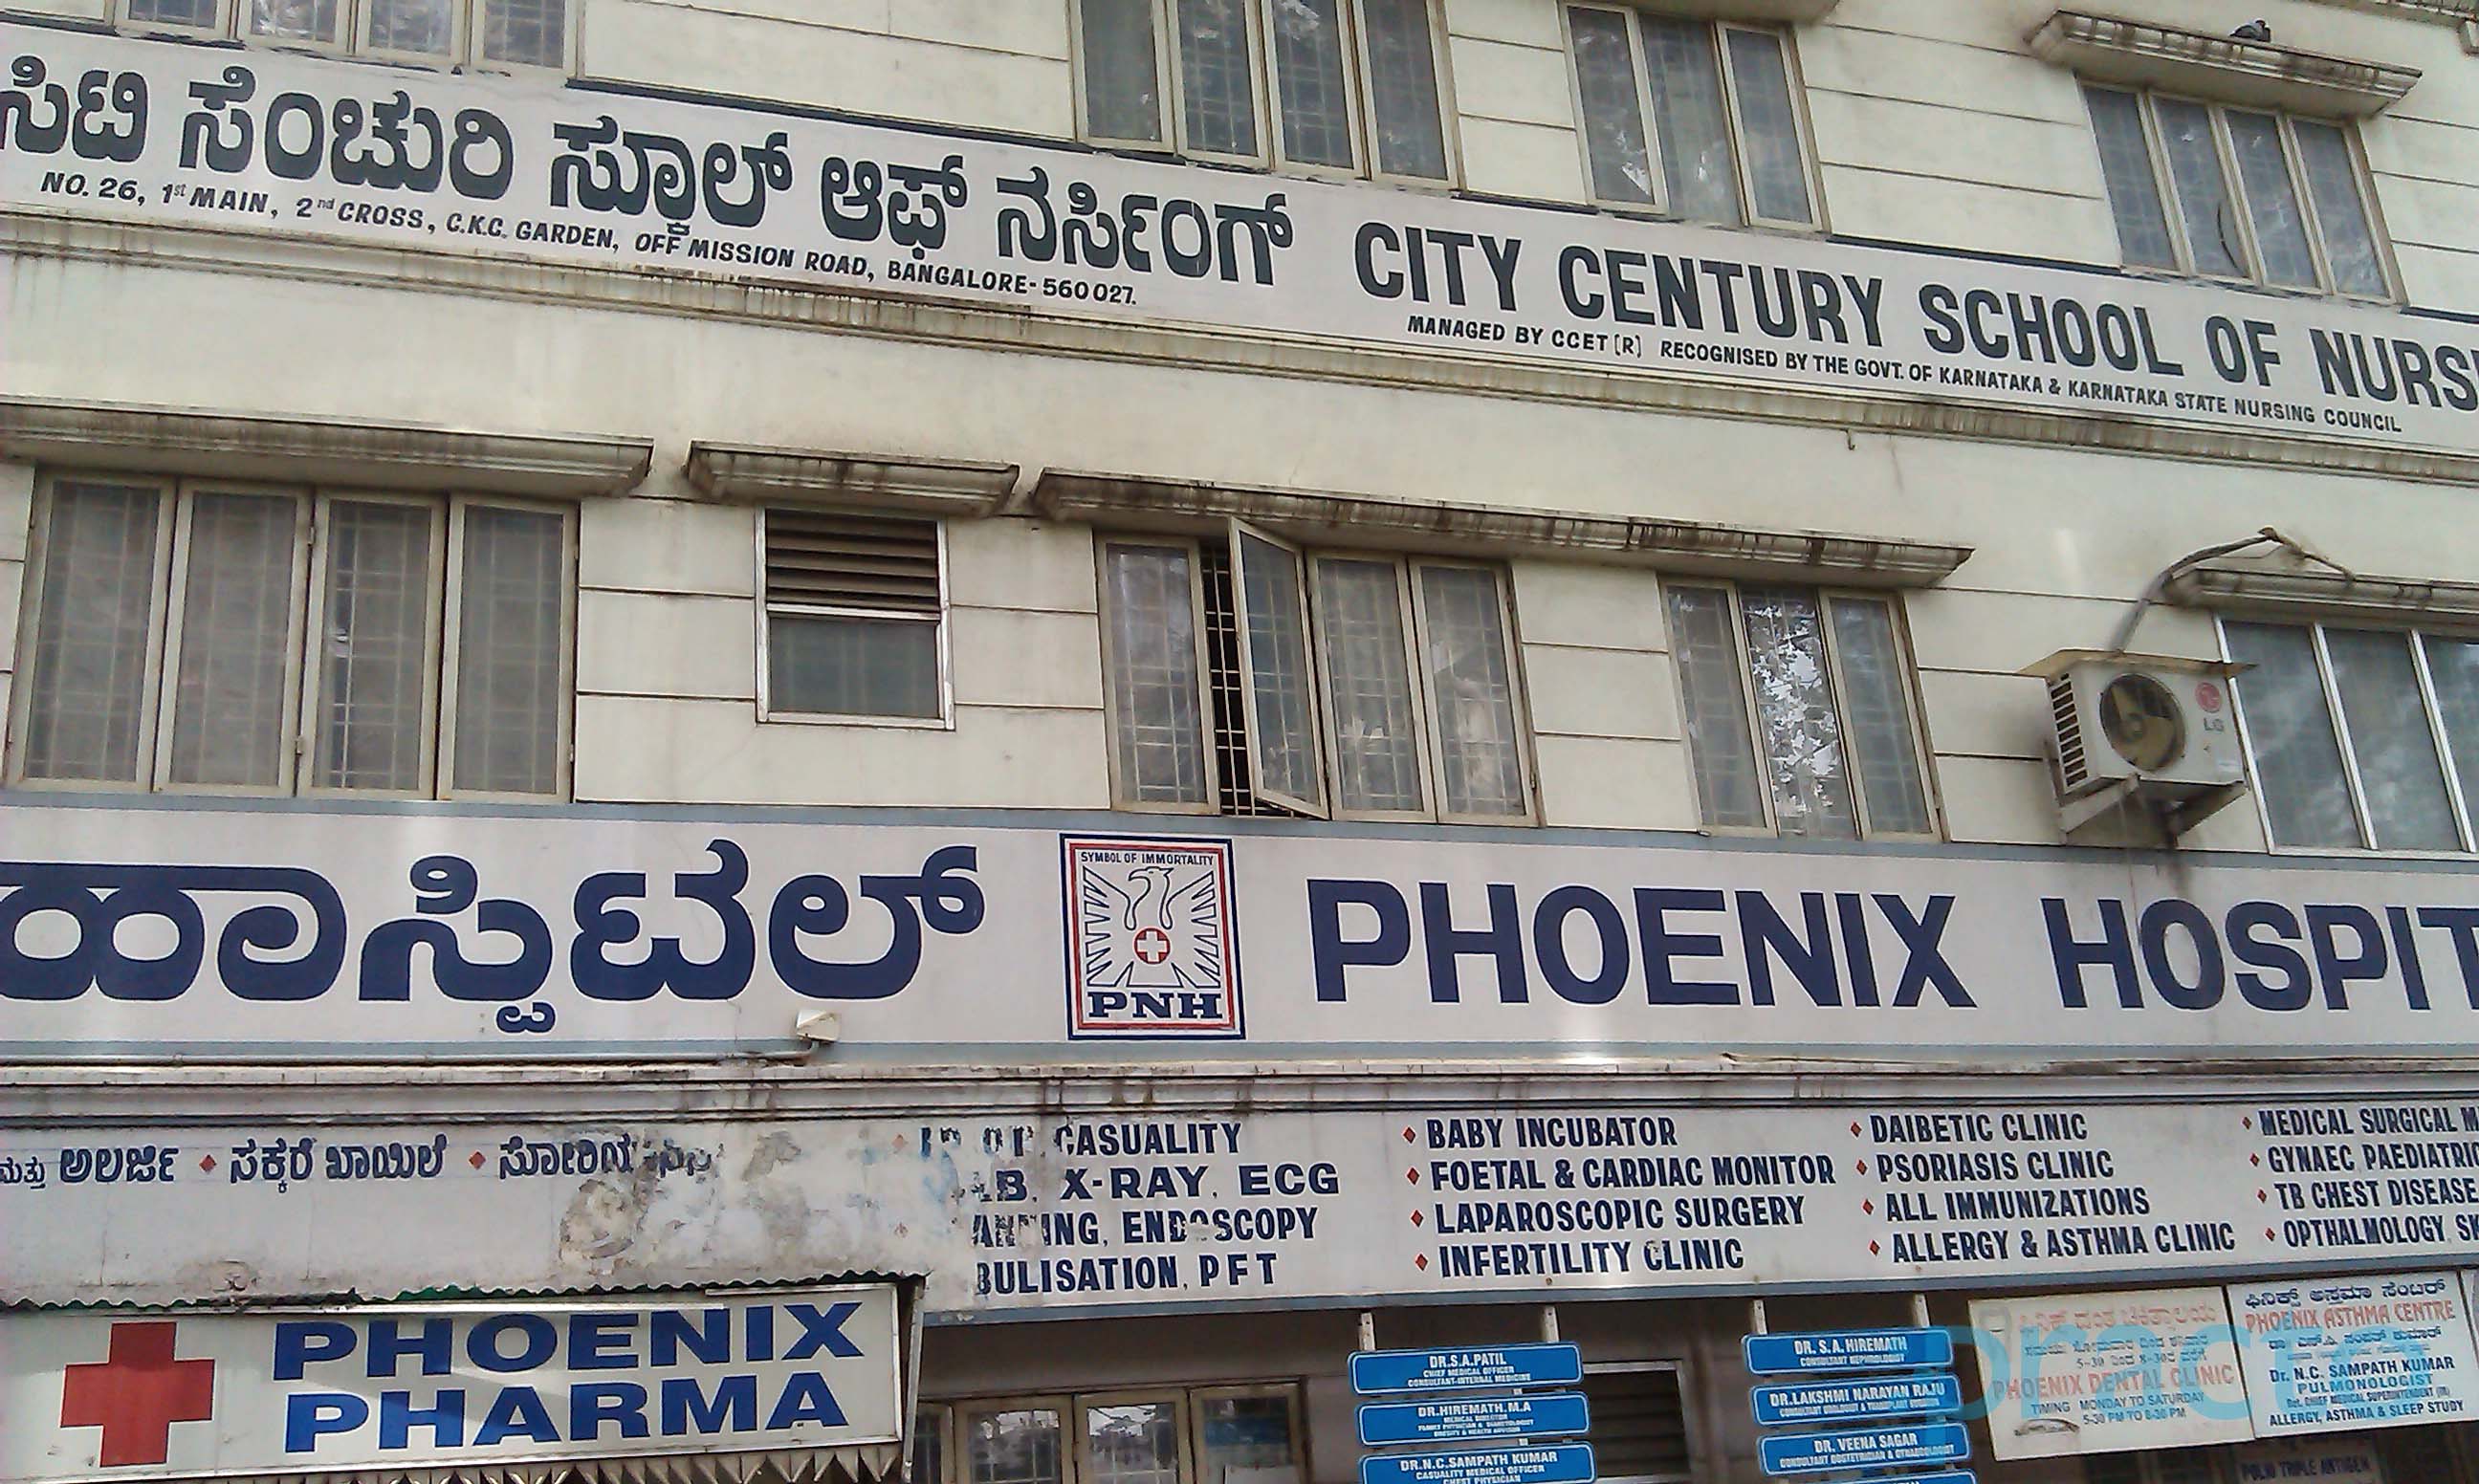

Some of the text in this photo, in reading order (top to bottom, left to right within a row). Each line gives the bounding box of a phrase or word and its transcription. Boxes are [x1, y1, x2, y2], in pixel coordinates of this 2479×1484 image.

[179, 65, 514, 199] ಸೆಂಚುರಿ
[550, 115, 792, 235] ಸ್ಕೂಲ್
[996, 165, 1295, 286] ನರ್ಸಿಂಗ್
[41, 171, 90, 197] NO.
[99, 179, 144, 207] 26,
[188, 187, 277, 218] MAIN,
[337, 202, 435, 234] CROSS,
[516, 221, 619, 252] GARDEN,
[635, 232, 681, 255] OFF
[688, 240, 794, 268] MISSION
[805, 251, 875, 283] ROAD,
[1354, 222, 1523, 312] CITY
[1558, 245, 1883, 347] CENTURY
[1918, 282, 2185, 378] SCHOOL
[2204, 315, 2282, 387] OF
[1408, 315, 1505, 341] MANAGED
[1515, 325, 1545, 345] BY
[1551, 330, 1609, 352] CCET
[1660, 339, 1779, 368] RECOGNISED
[1785, 350, 1809, 371] BY
[1812, 354, 1849, 375] THE
[1854, 359, 1904, 380] GOVT.
[1909, 364, 1933, 382] OF
[1940, 366, 2044, 395] KARNATAKA
[2049, 377, 2062, 395] &
[2068, 380, 2169, 407] KARNATAKA
[2175, 391, 2227, 414] STATE
[2234, 399, 2315, 424] NURSING
[2324, 408, 2402, 432] COUNCIL
[2204, 718, 2225, 731] LG
[1081, 851, 1214, 866] SYMBOL OF IMMORTALITY
[1305, 877, 1979, 1010] PHOENIX
[1087, 992, 1223, 1019] PNH
[1426, 1116, 1678, 1149] BABY INCUBATOR
[1869, 1112, 2088, 1144] DAIBETIC CLINIC
[2258, 1106, 2458, 1136] MEDICAL SURGICAL
[1055, 1122, 1241, 1155] CASUALITY
[1239, 1164, 1339, 1195] ECG
[1430, 1154, 1836, 1192] FOETAL & CARDIAC MONITOR
[1875, 1149, 2115, 1183] PSORIASIS CLINIC
[1886, 1187, 2151, 1222] ALL IMMUNIZATIONS
[2273, 1177, 2479, 1210] TB CHEST DISEASE
[1434, 1195, 1806, 1234] LAPAROSCOPIC SURGERY
[1438, 1238, 1744, 1278] INFERTILITY CLINIC
[1892, 1222, 2236, 1263] ALLERGY & ASTHMA CLINIC
[2245, 1308, 2320, 1334] PHOENIX
[2323, 1303, 2392, 1329] ASTHMA
[2394, 1299, 2456, 1323] CENTRE
[272, 1300, 866, 1381] PHOENIX
[1992, 1364, 2235, 1400] PHOENIX DENTAL CLINIC
[2269, 1369, 2291, 1383] Dr.
[2329, 1359, 2399, 1378] SAMPATH
[2402, 1356, 2455, 1373] KUMAR
[2297, 1373, 2434, 1394] PULMONOLOGIST
[1853, 1386, 1909, 1401] NARAYAN
[1913, 1383, 1945, 1397] RAJU
[2030, 1391, 2205, 1415] TIMING MONDAY TO SATURDAY
[284, 1372, 850, 1453] PHARMA
[2108, 1412, 2125, 1423] PM
[2127, 1410, 2143, 1421] TO
[2169, 1407, 2187, 1418] PM
[2270, 1400, 2465, 1427] ALLERGY, ASTHMA & SLEEP STUDY
[1512, 1451, 1558, 1464] KUMAR
[1814, 1433, 1918, 1453] DR. VEENA SAGAR
[1466, 1466, 1505, 1476] MEDICAL
[1507, 1465, 1546, 1474] OFFICER
